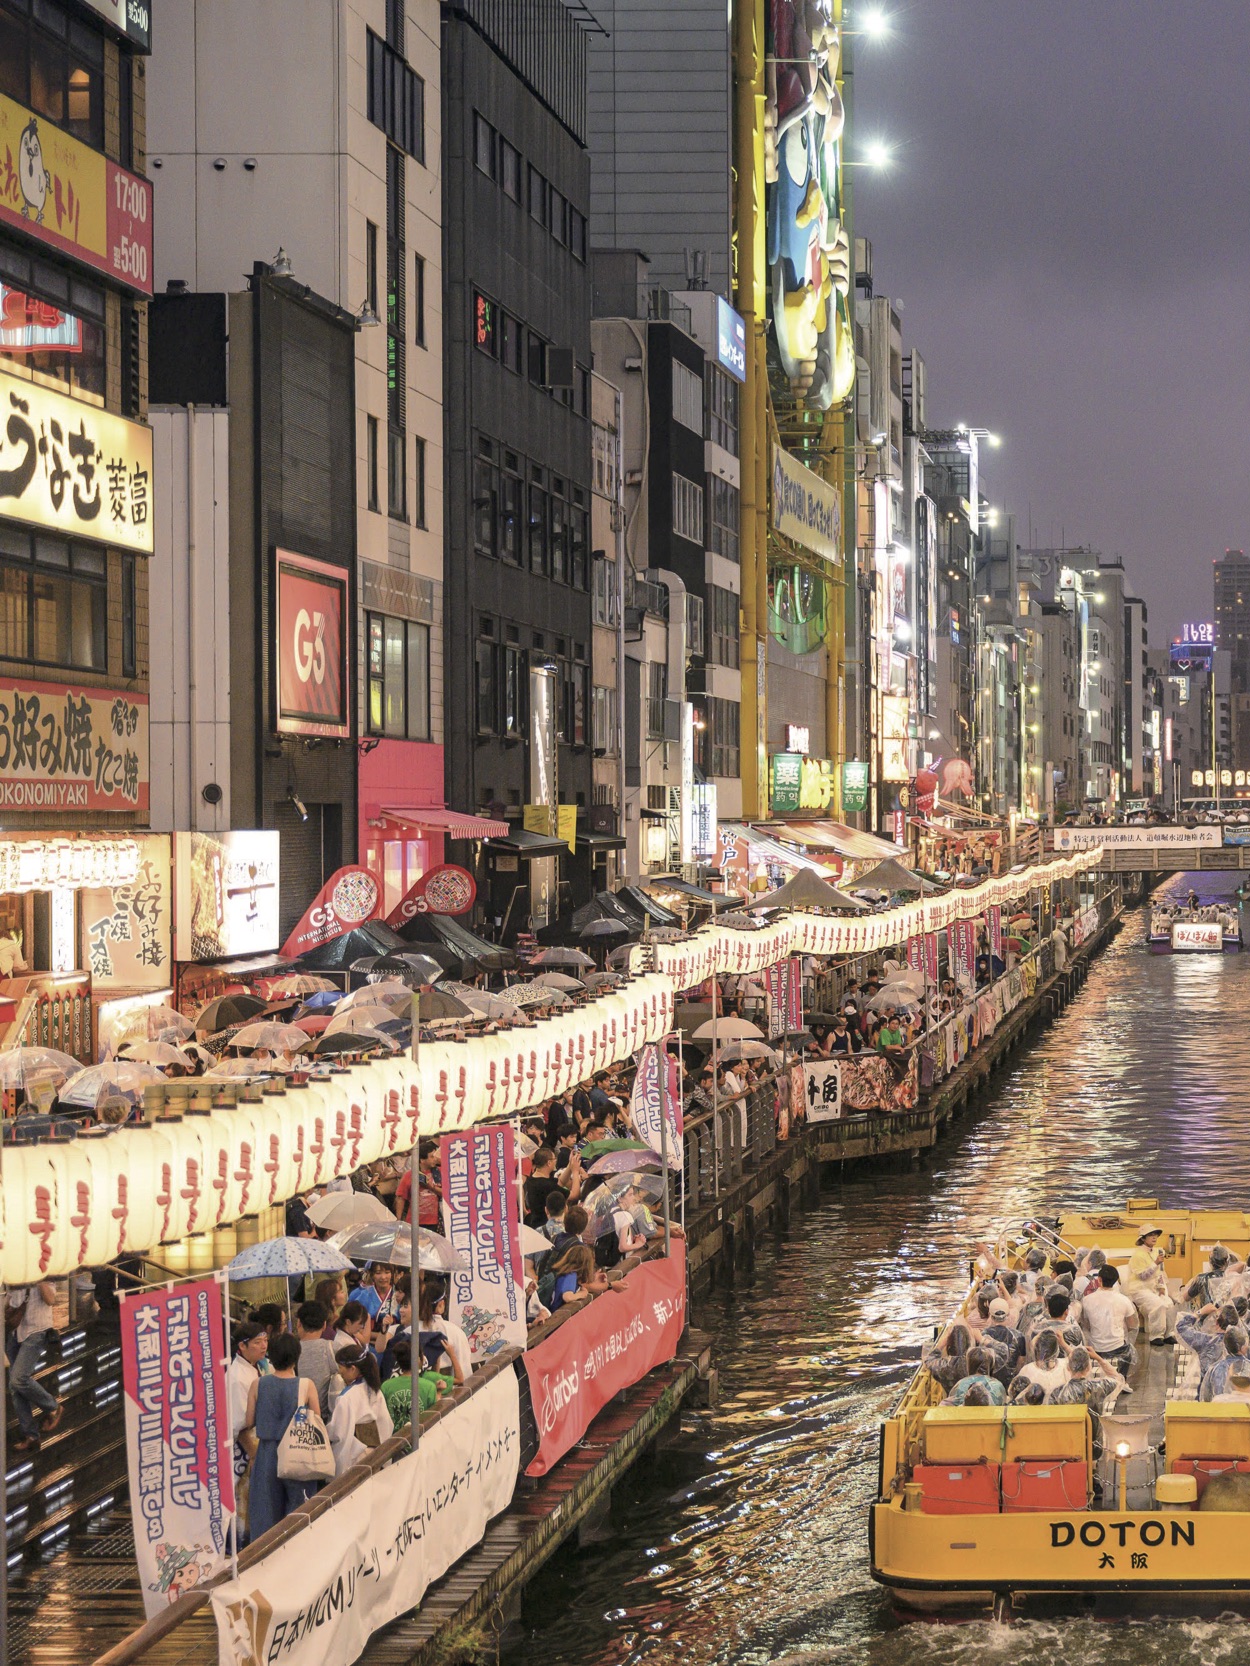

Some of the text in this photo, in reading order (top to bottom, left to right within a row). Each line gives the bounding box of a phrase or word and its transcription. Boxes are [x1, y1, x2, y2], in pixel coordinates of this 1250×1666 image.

[114, 172, 147, 222] 17:00
[294, 608, 326, 685] G3
[720, 829, 738, 867] 神戸
[133, 861, 167, 967] お好み焼
[309, 902, 335, 928] G3
[401, 895, 428, 918] G3
[1177, 930, 1218, 944] ぽんぽん船
[808, 1074, 838, 1106] 千房
[1050, 1520, 1196, 1547] DOTON
[1098, 1552, 1149, 1570] 大阪
